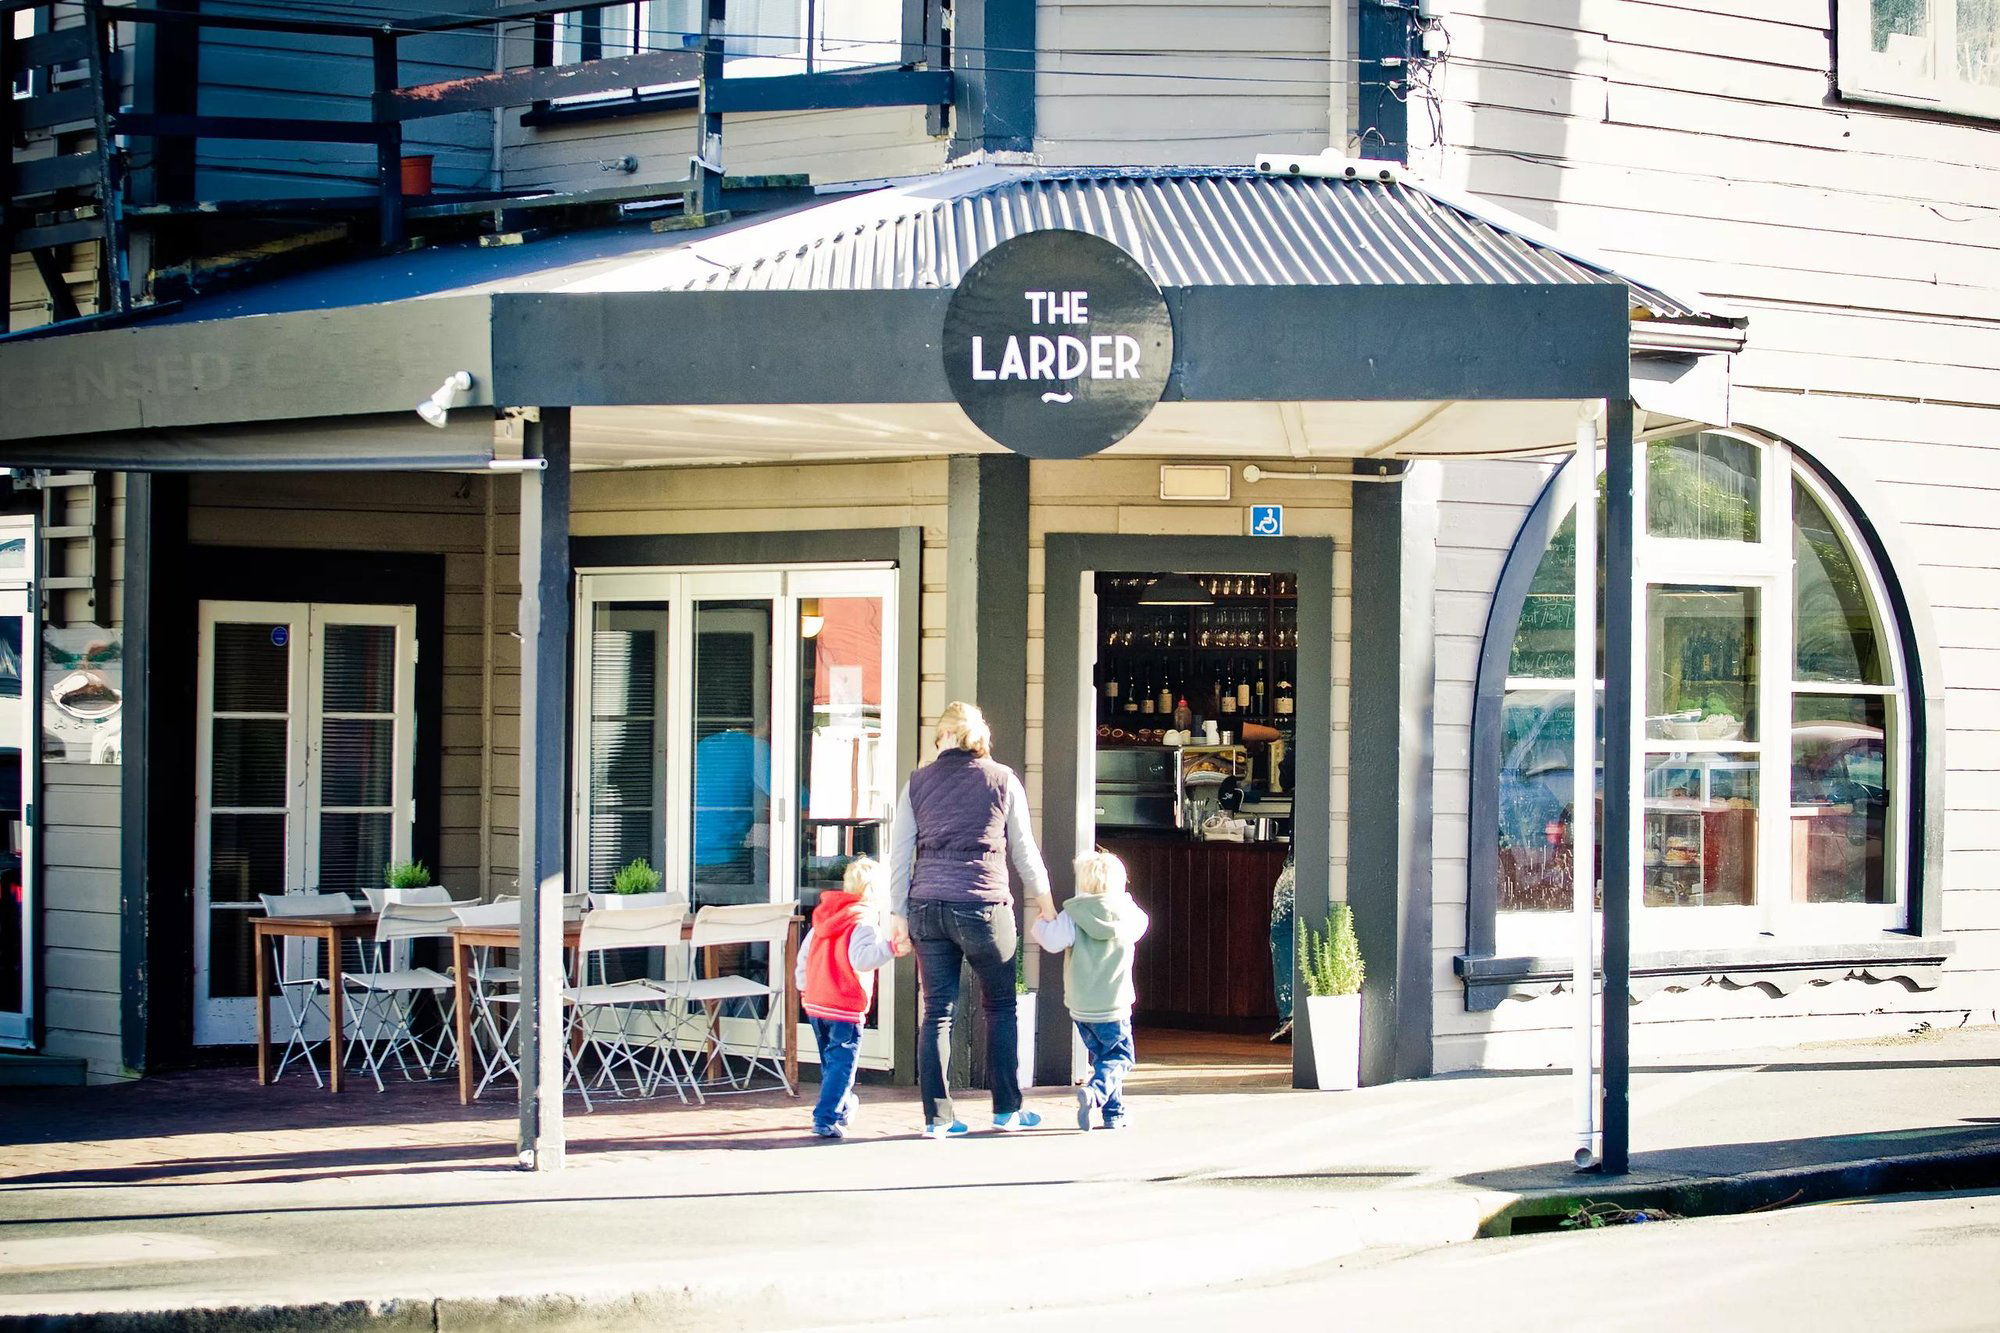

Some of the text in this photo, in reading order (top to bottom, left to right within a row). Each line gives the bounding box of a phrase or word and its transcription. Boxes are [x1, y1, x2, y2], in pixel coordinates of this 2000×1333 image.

[1024, 291, 1088, 325] THE
[3, 351, 233, 407] ENSED
[971, 335, 1142, 381] LARDER
